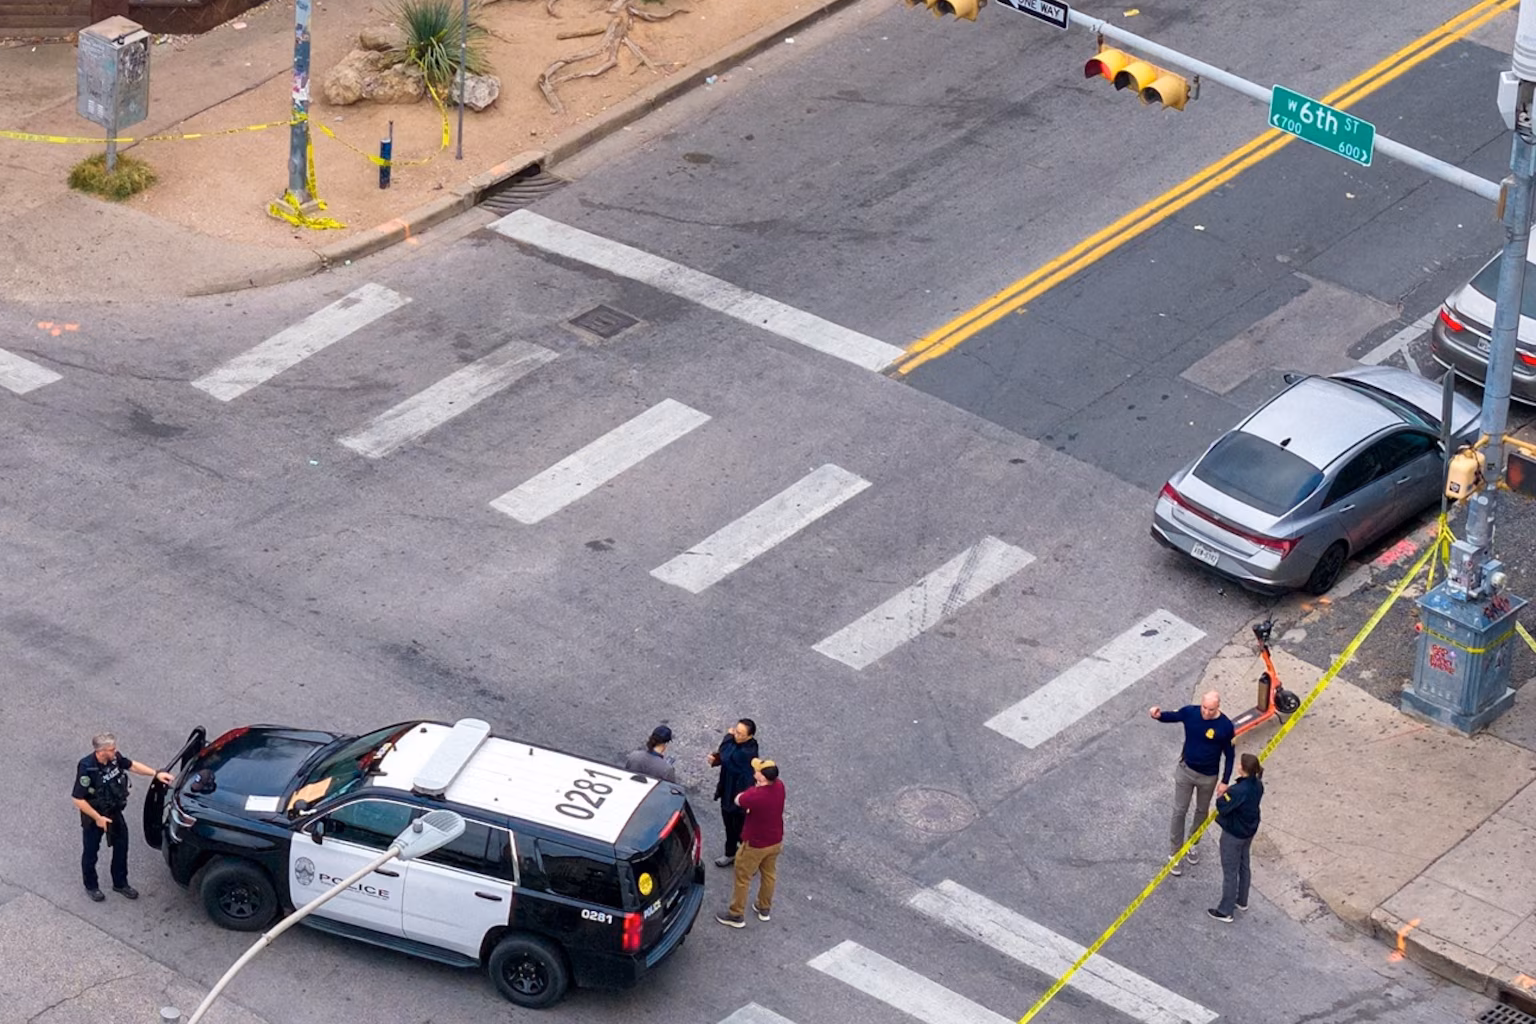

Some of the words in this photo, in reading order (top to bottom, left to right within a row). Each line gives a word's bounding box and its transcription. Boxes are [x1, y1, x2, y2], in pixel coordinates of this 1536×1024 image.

[1040, 2, 1060, 17] WAY
[1281, 116, 1303, 134] 700
[1288, 98, 1298, 112] W
[1300, 102, 1338, 135] 6th
[1344, 118, 1360, 134] ST
[1339, 142, 1360, 159] 600
[555, 768, 622, 820] 0281
[319, 873, 390, 897] POICE
[581, 909, 613, 924] 0281
